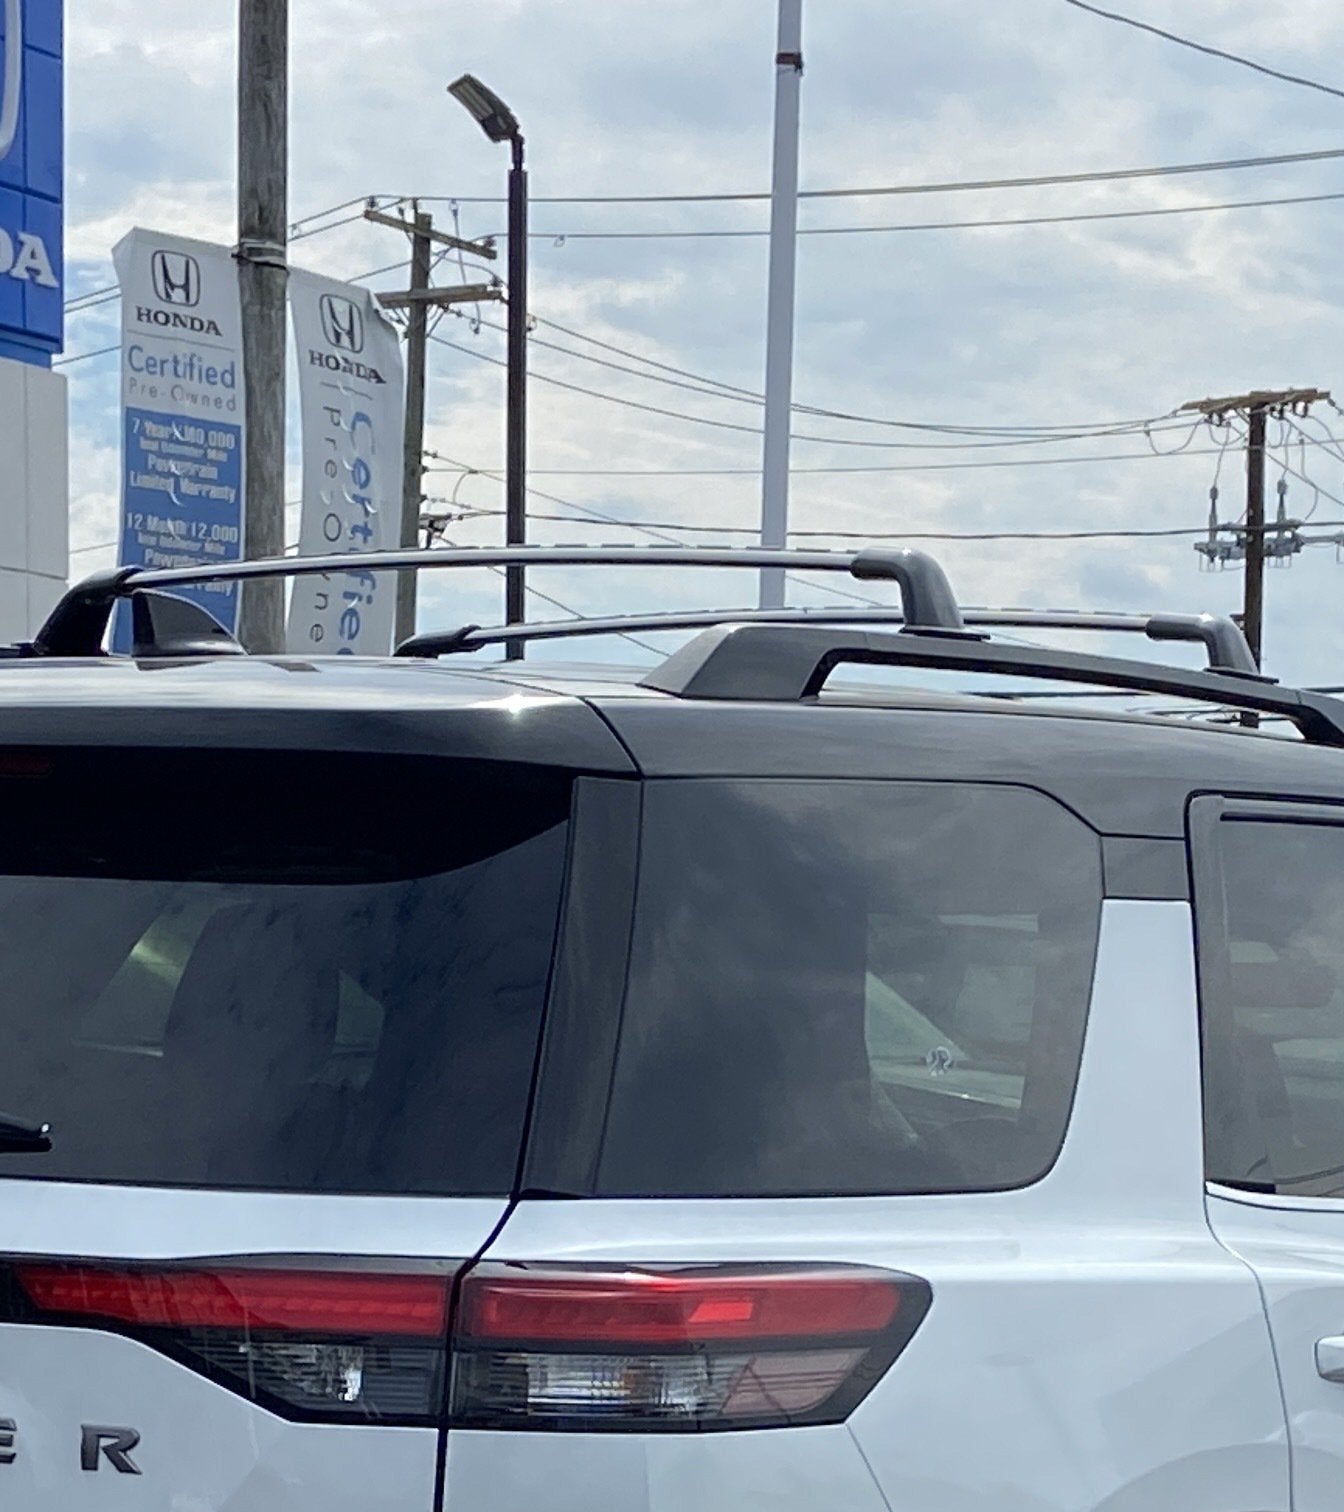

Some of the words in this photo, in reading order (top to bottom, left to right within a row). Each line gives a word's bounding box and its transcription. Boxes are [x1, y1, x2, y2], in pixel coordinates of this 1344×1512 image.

[136, 306, 223, 337] HONDA
[128, 344, 236, 389] Certified
[129, 377, 237, 412] Pre-Owned
